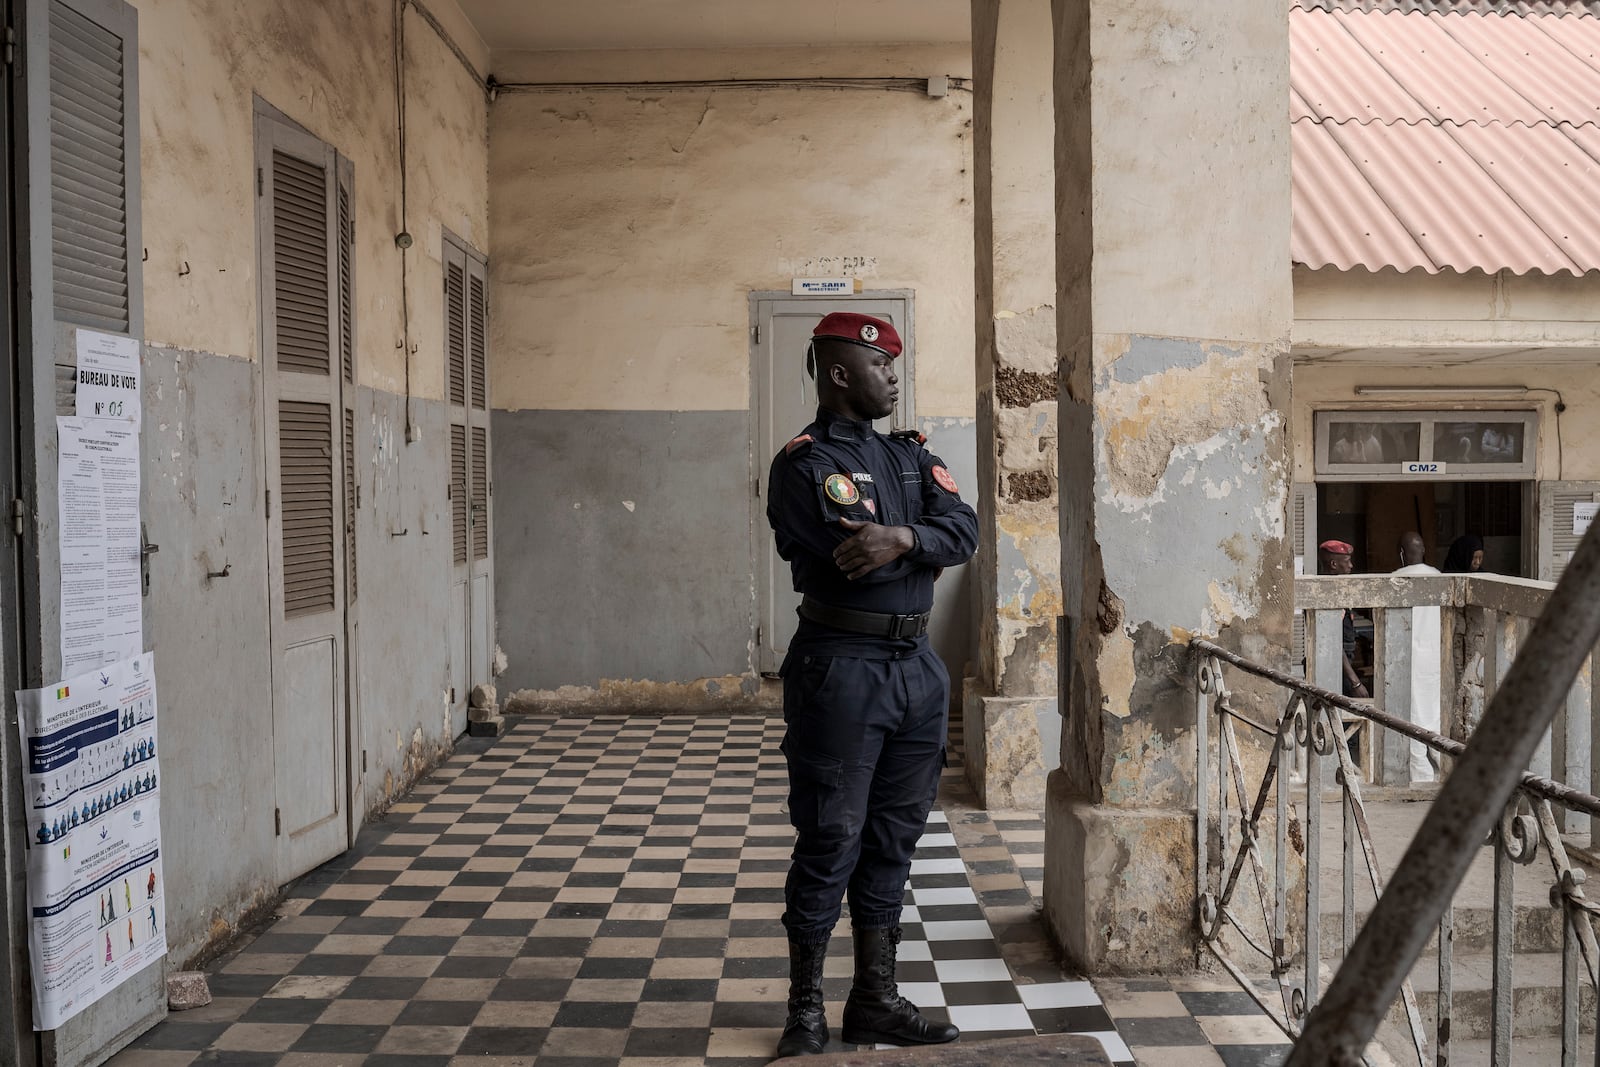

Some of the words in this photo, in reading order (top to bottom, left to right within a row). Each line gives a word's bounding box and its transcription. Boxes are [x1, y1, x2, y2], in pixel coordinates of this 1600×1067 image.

[80, 370, 109, 387] BUREAU
[111, 374, 119, 388] DE
[121, 376, 136, 390] VOTE
[95, 402, 104, 415] N°
[109, 401, 123, 416] 05
[1409, 463, 1438, 472] CM2
[852, 472, 874, 482] POLICE
[35, 721, 59, 734] DIRECTION
